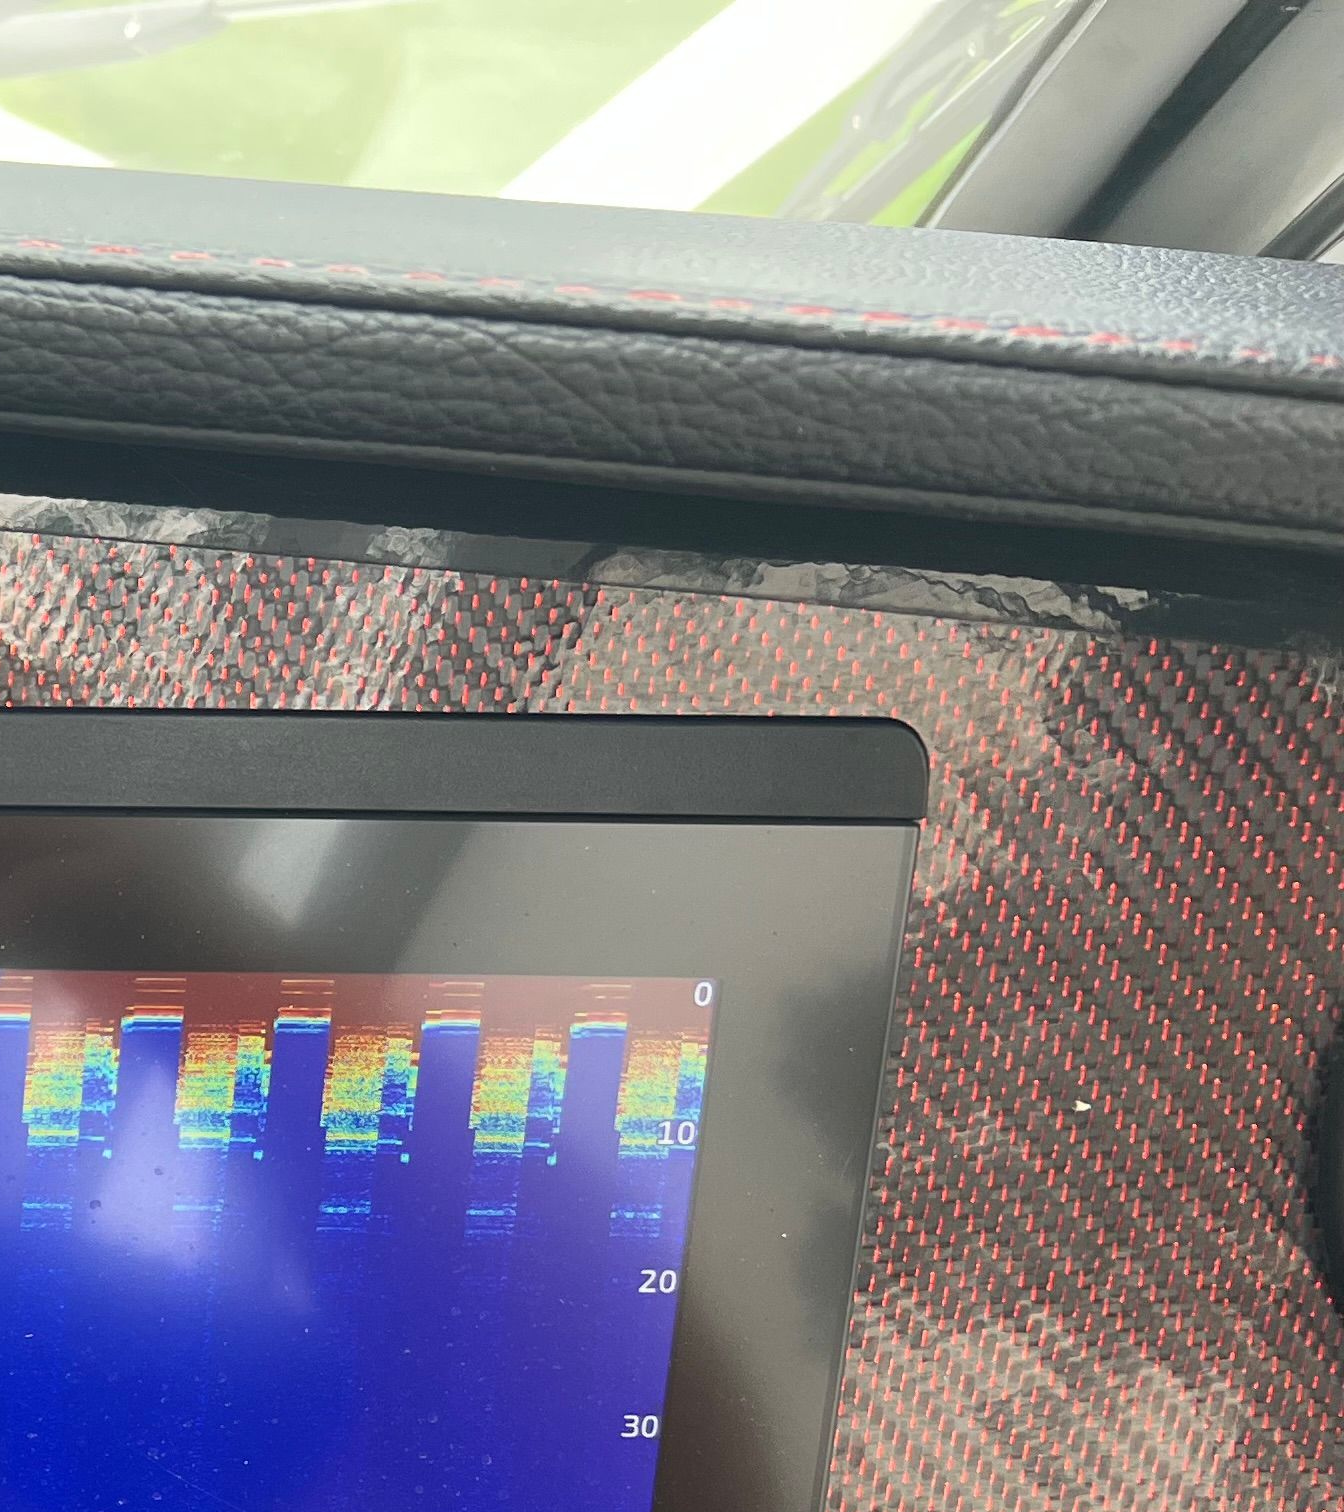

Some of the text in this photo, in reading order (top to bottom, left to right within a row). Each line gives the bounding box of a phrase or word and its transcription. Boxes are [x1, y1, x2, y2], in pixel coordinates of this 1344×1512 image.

[694, 981, 713, 1006] 0
[657, 1120, 695, 1145] 10
[638, 1269, 676, 1294] 20
[621, 1415, 658, 1438] 30
